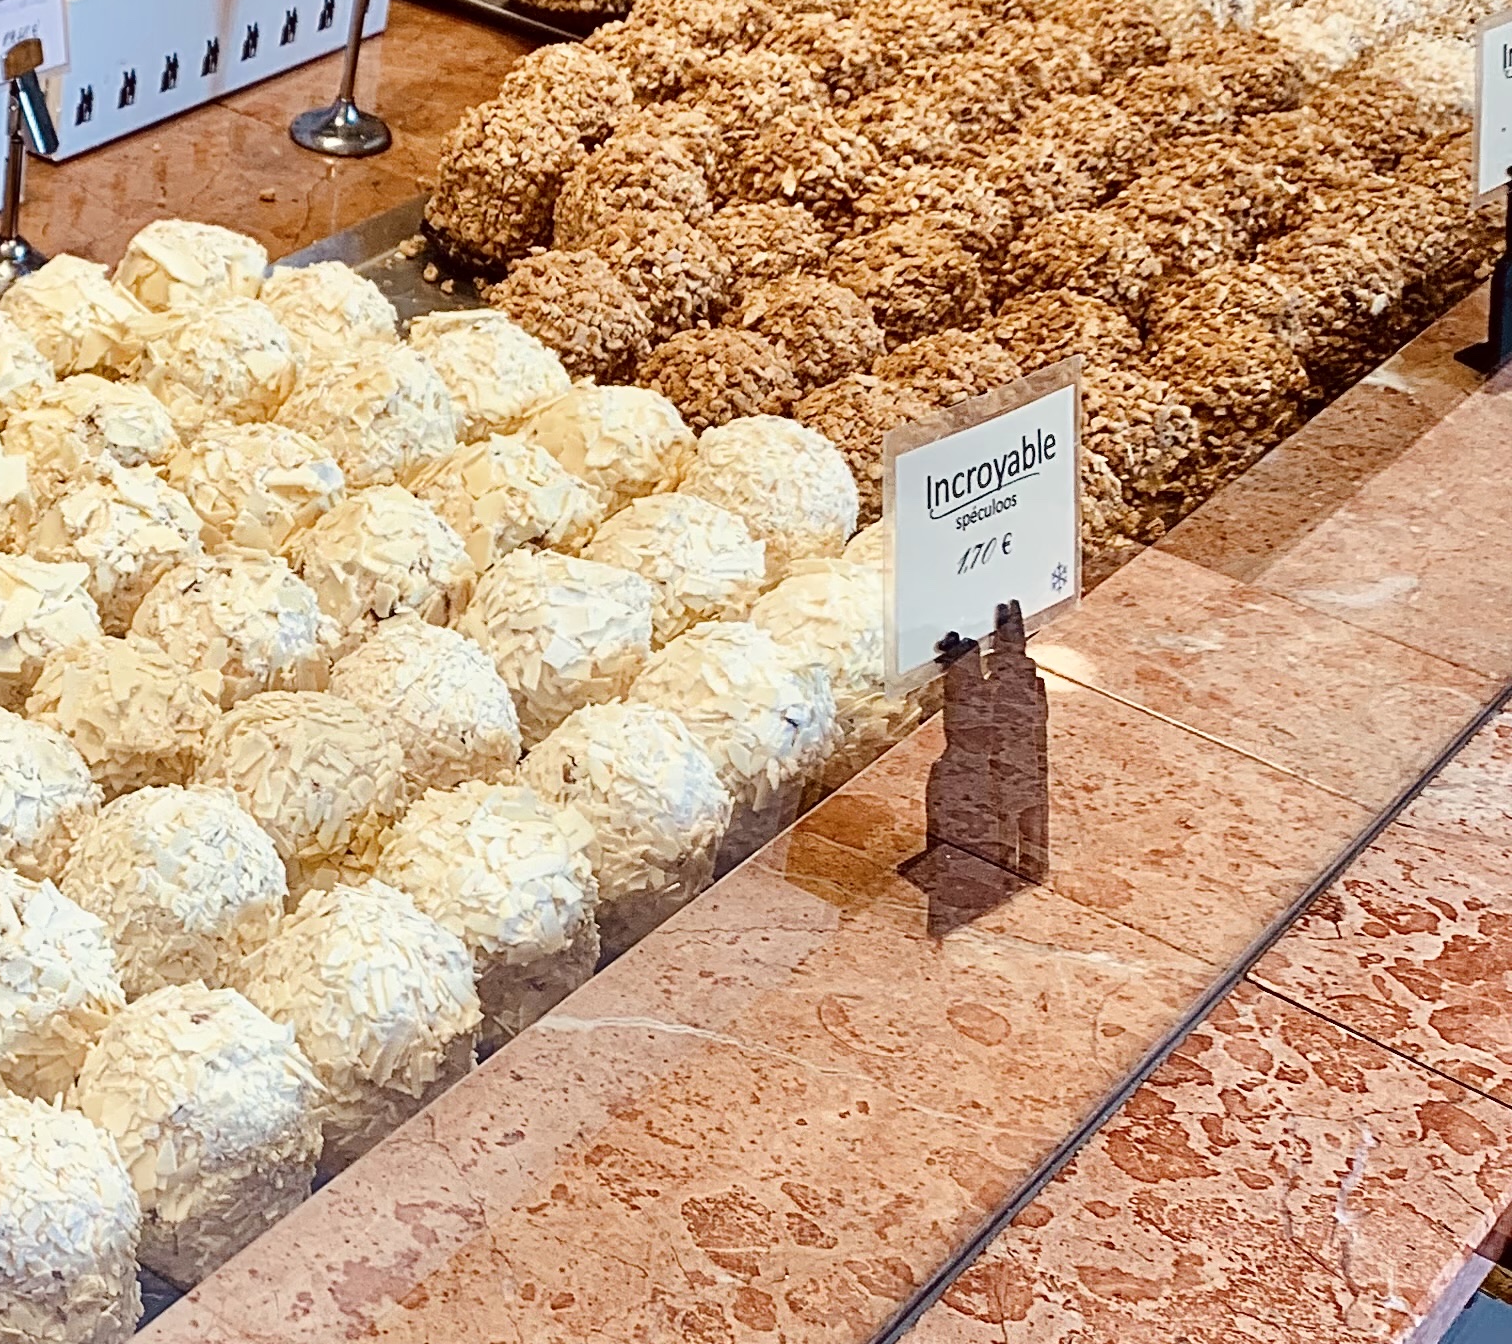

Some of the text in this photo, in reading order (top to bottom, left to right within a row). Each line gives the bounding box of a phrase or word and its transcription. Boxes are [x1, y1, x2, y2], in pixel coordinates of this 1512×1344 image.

[926, 428, 1056, 510] Incroyable
[955, 493, 1017, 531] spéculoos
[957, 532, 1013, 575] 1,70 €
